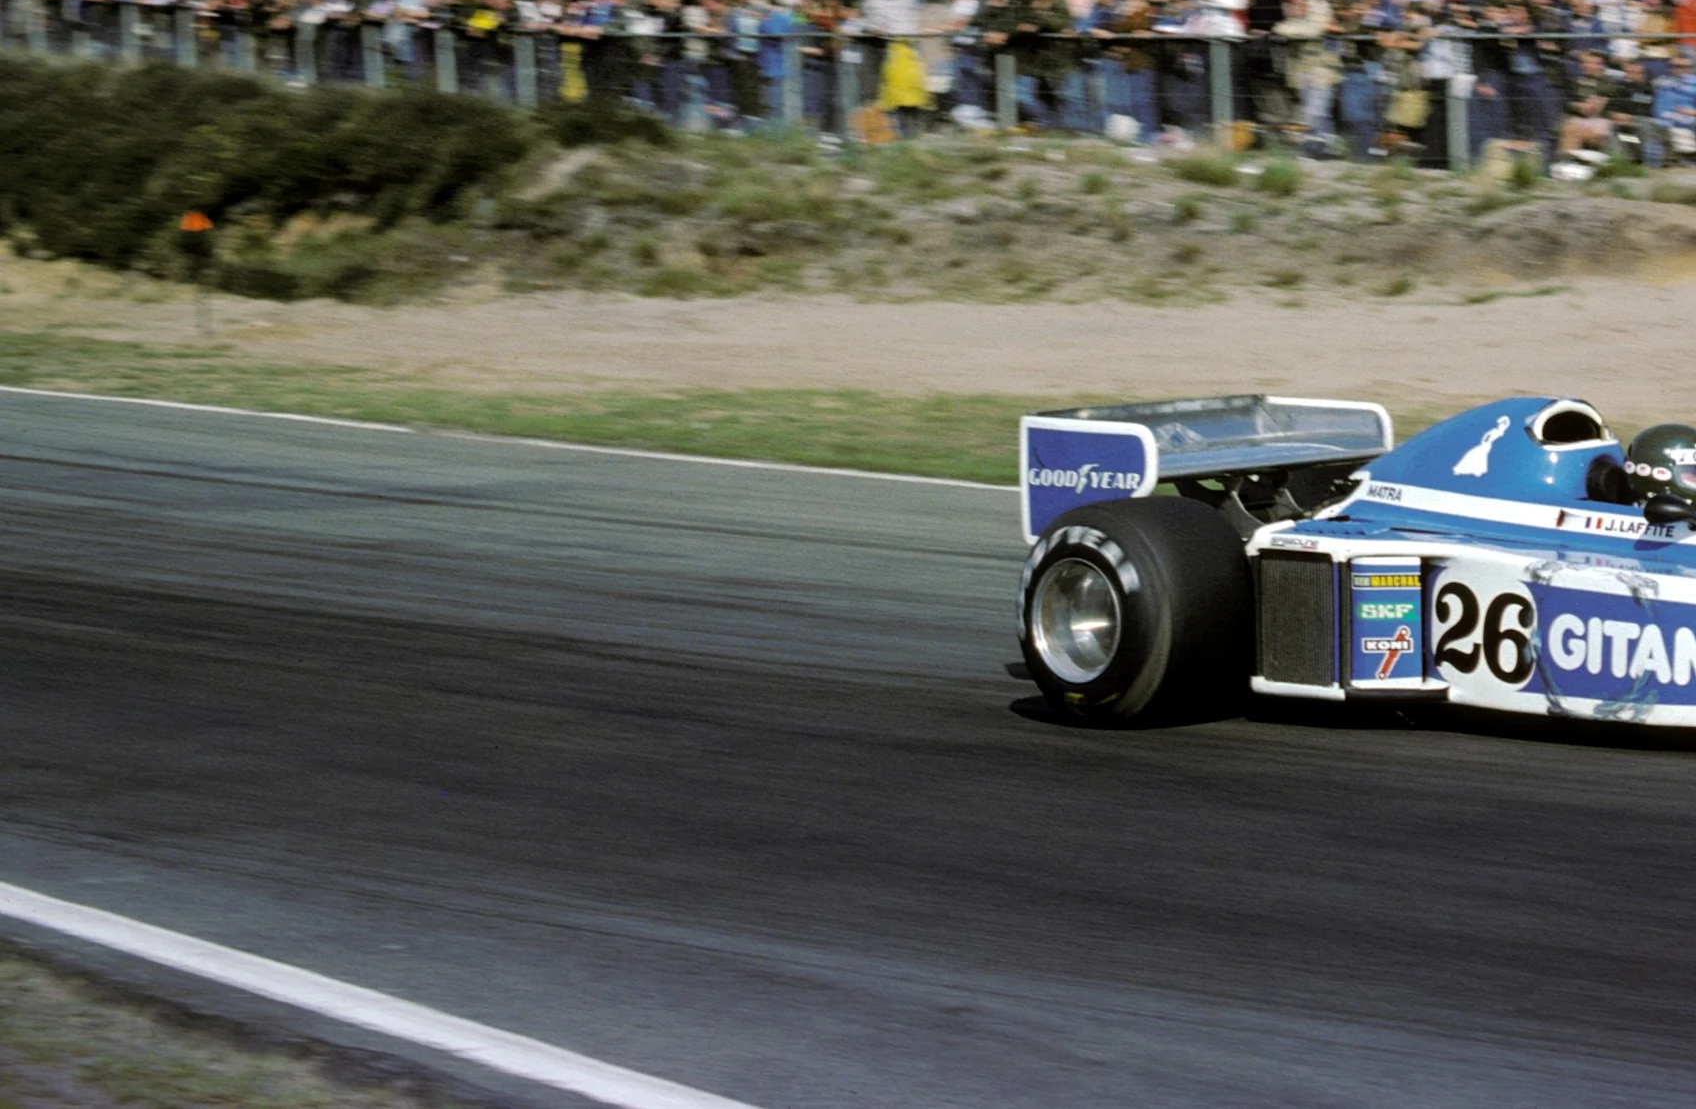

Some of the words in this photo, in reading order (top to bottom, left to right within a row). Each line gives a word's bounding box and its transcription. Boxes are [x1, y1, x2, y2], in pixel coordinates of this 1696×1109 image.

[1028, 464, 1141, 494] GOODYEAR
[1367, 485, 1402, 501] MATRA
[1361, 604, 1413, 618] SKF
[1435, 582, 1535, 684] 26
[1366, 641, 1409, 650] KONI
